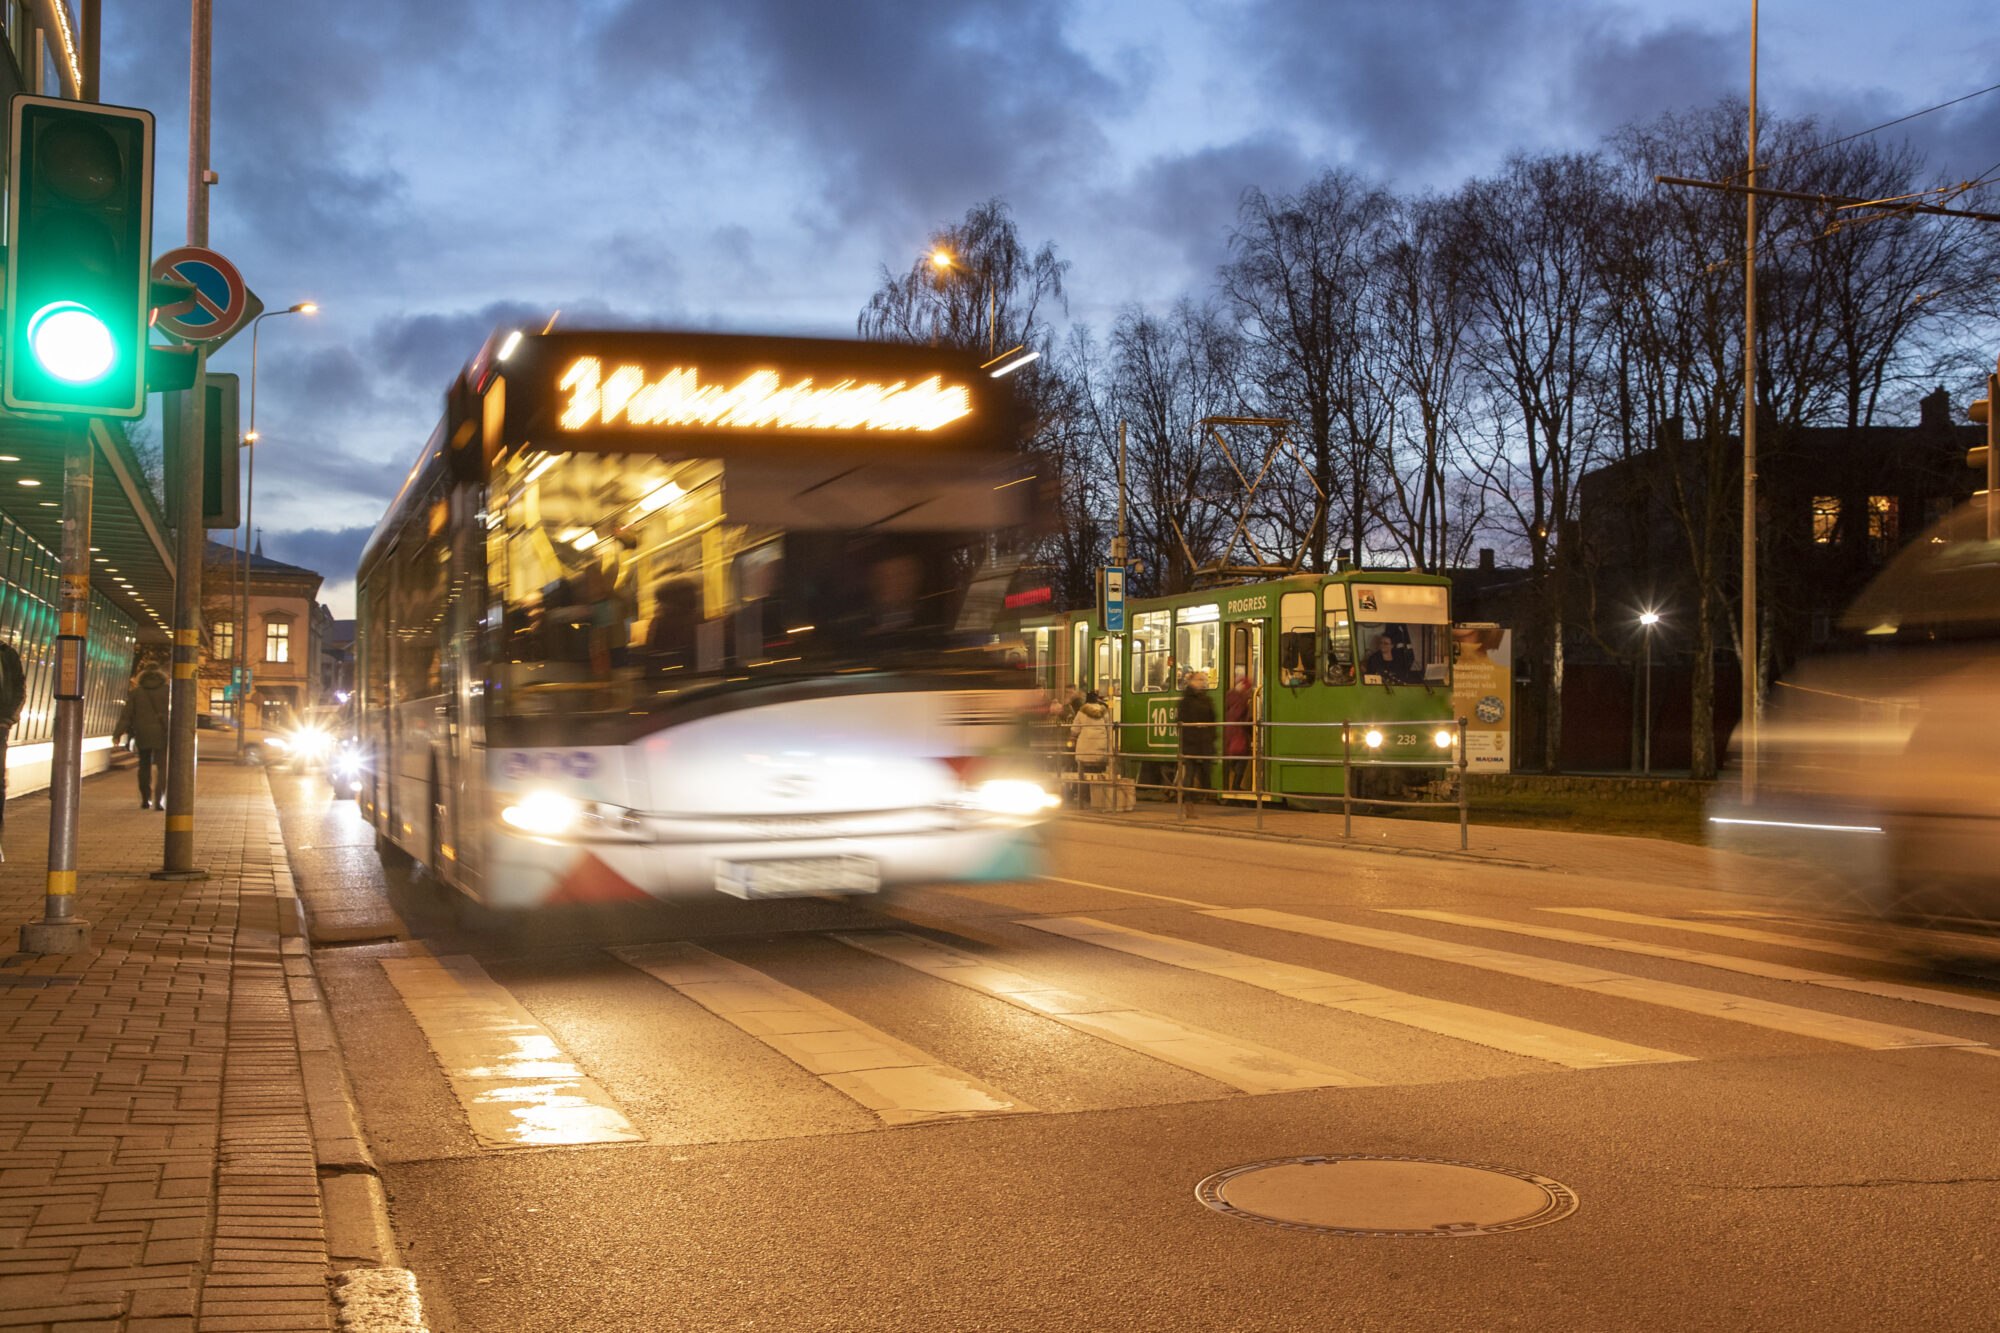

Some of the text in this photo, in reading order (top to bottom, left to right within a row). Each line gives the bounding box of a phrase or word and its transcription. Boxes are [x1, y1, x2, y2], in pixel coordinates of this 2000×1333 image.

[1228, 595, 1267, 614] PROGRESS
[1152, 708, 1167, 736] 10
[1397, 735, 1417, 745] 238
